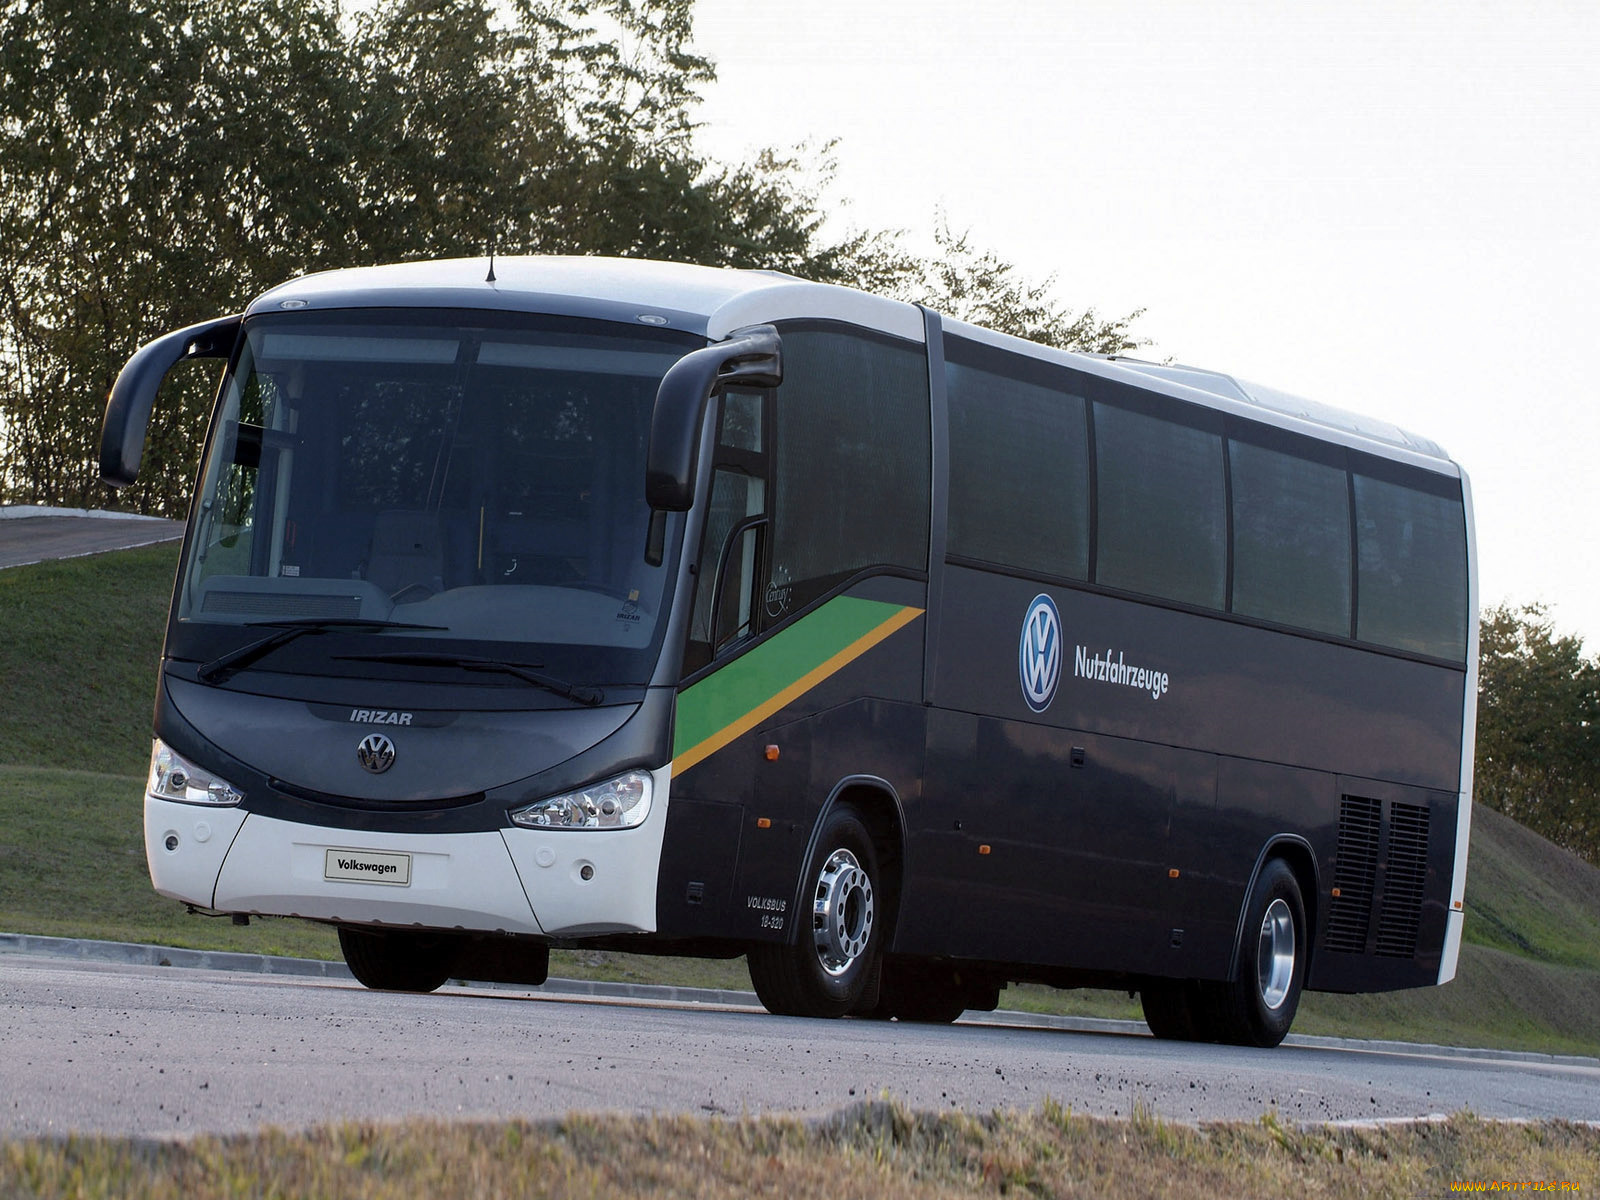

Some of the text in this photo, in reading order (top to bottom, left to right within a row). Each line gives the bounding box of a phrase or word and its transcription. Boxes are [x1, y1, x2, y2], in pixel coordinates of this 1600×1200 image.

[1074, 645, 1169, 700] Nutzfahrzeuge
[349, 709, 413, 725] IRIZAR
[337, 859, 397, 875] Volkswagen
[747, 896, 786, 911] VOLKSBUS
